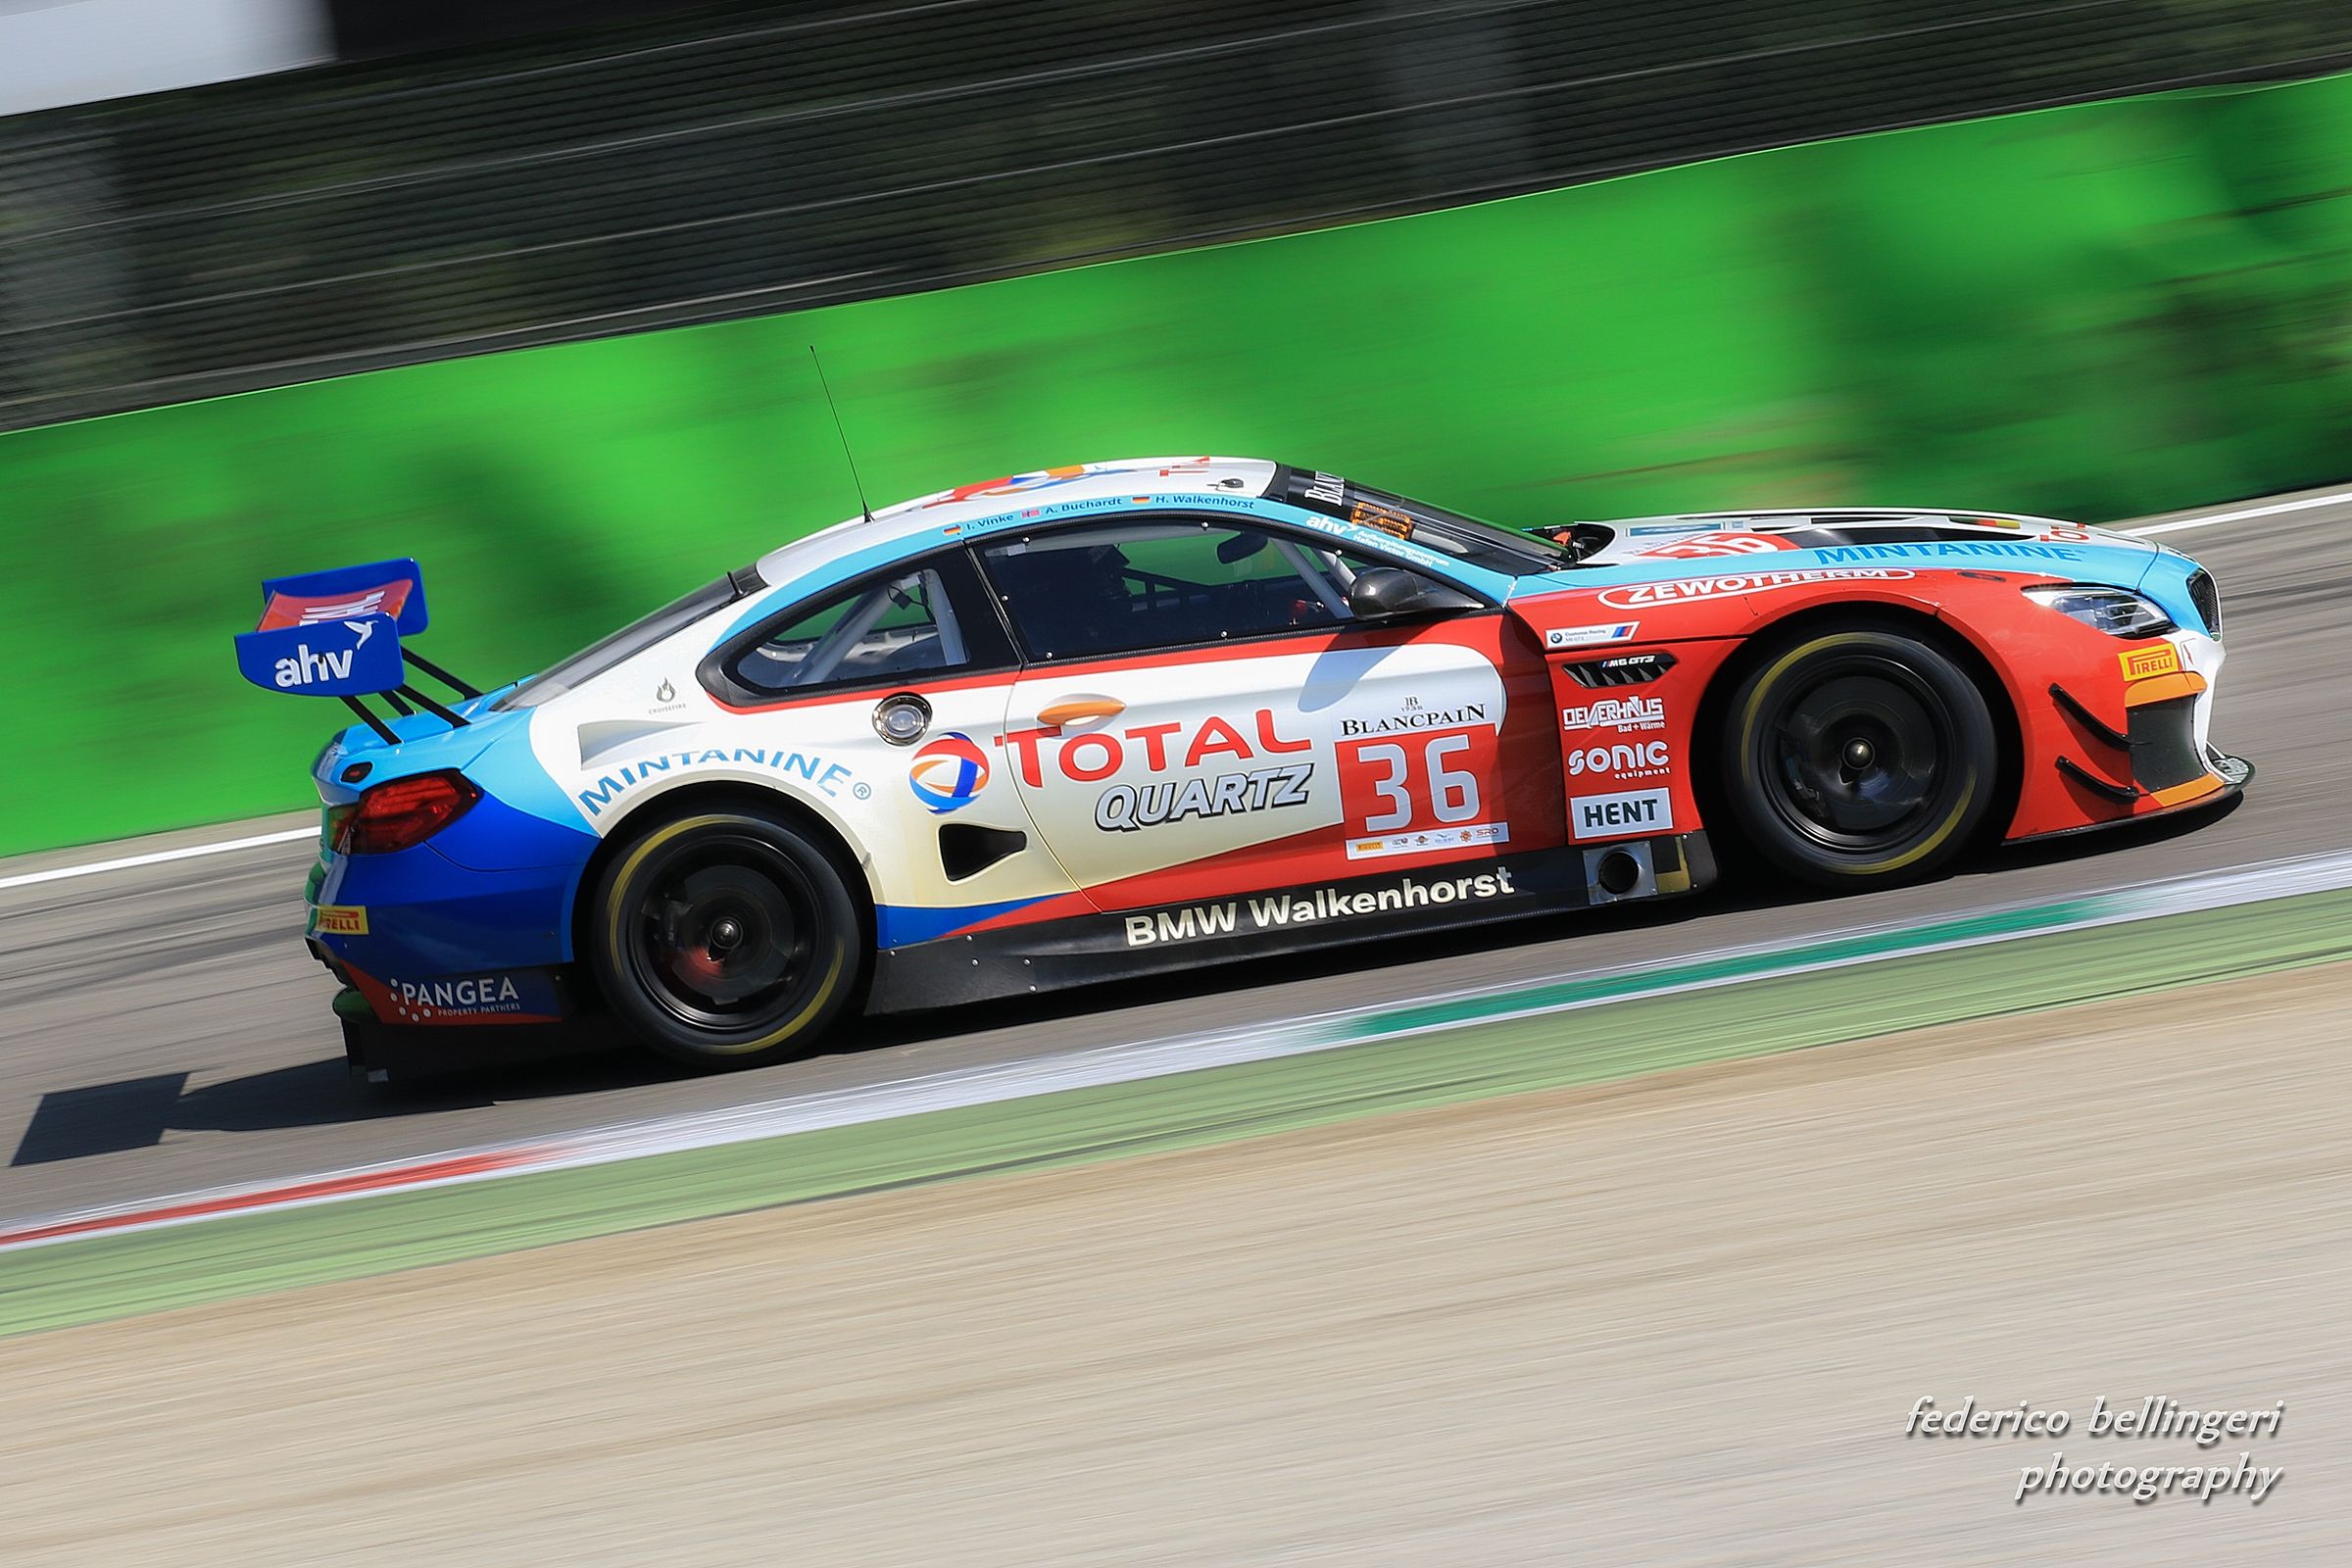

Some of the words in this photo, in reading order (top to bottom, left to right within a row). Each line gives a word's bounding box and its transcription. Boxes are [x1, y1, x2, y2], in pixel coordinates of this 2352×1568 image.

[1045, 506, 1059, 515] A.
[1061, 498, 1122, 512] Buchardt
[1155, 495, 1169, 505] H.
[1173, 493, 1255, 510] Walkenhorst
[977, 514, 1014, 527] Vinke
[1306, 514, 1344, 535] ahv
[1813, 543, 2083, 565] MINTANINE
[1627, 568, 1888, 604] ZEWOTHERM
[273, 644, 354, 688] ahv
[2127, 649, 2174, 676] PIRELLI
[1341, 703, 1486, 736] BLANCPAIN
[1617, 723, 1633, 733] Bad
[1640, 721, 1665, 731] Wärme
[994, 709, 1311, 788] TOTAL
[578, 748, 853, 817] MINTANINE
[1356, 734, 1482, 832] 36
[1614, 767, 1671, 780] equipment
[1094, 762, 1314, 832] QUARTZ
[1583, 798, 1658, 828] HENT
[1125, 902, 1237, 948] BMW
[1244, 865, 1516, 930] Walkenhorst
[401, 976, 519, 1006] PANGEA
[438, 1005, 477, 1017] PROPERTY
[480, 1003, 521, 1014] PARTNERS
